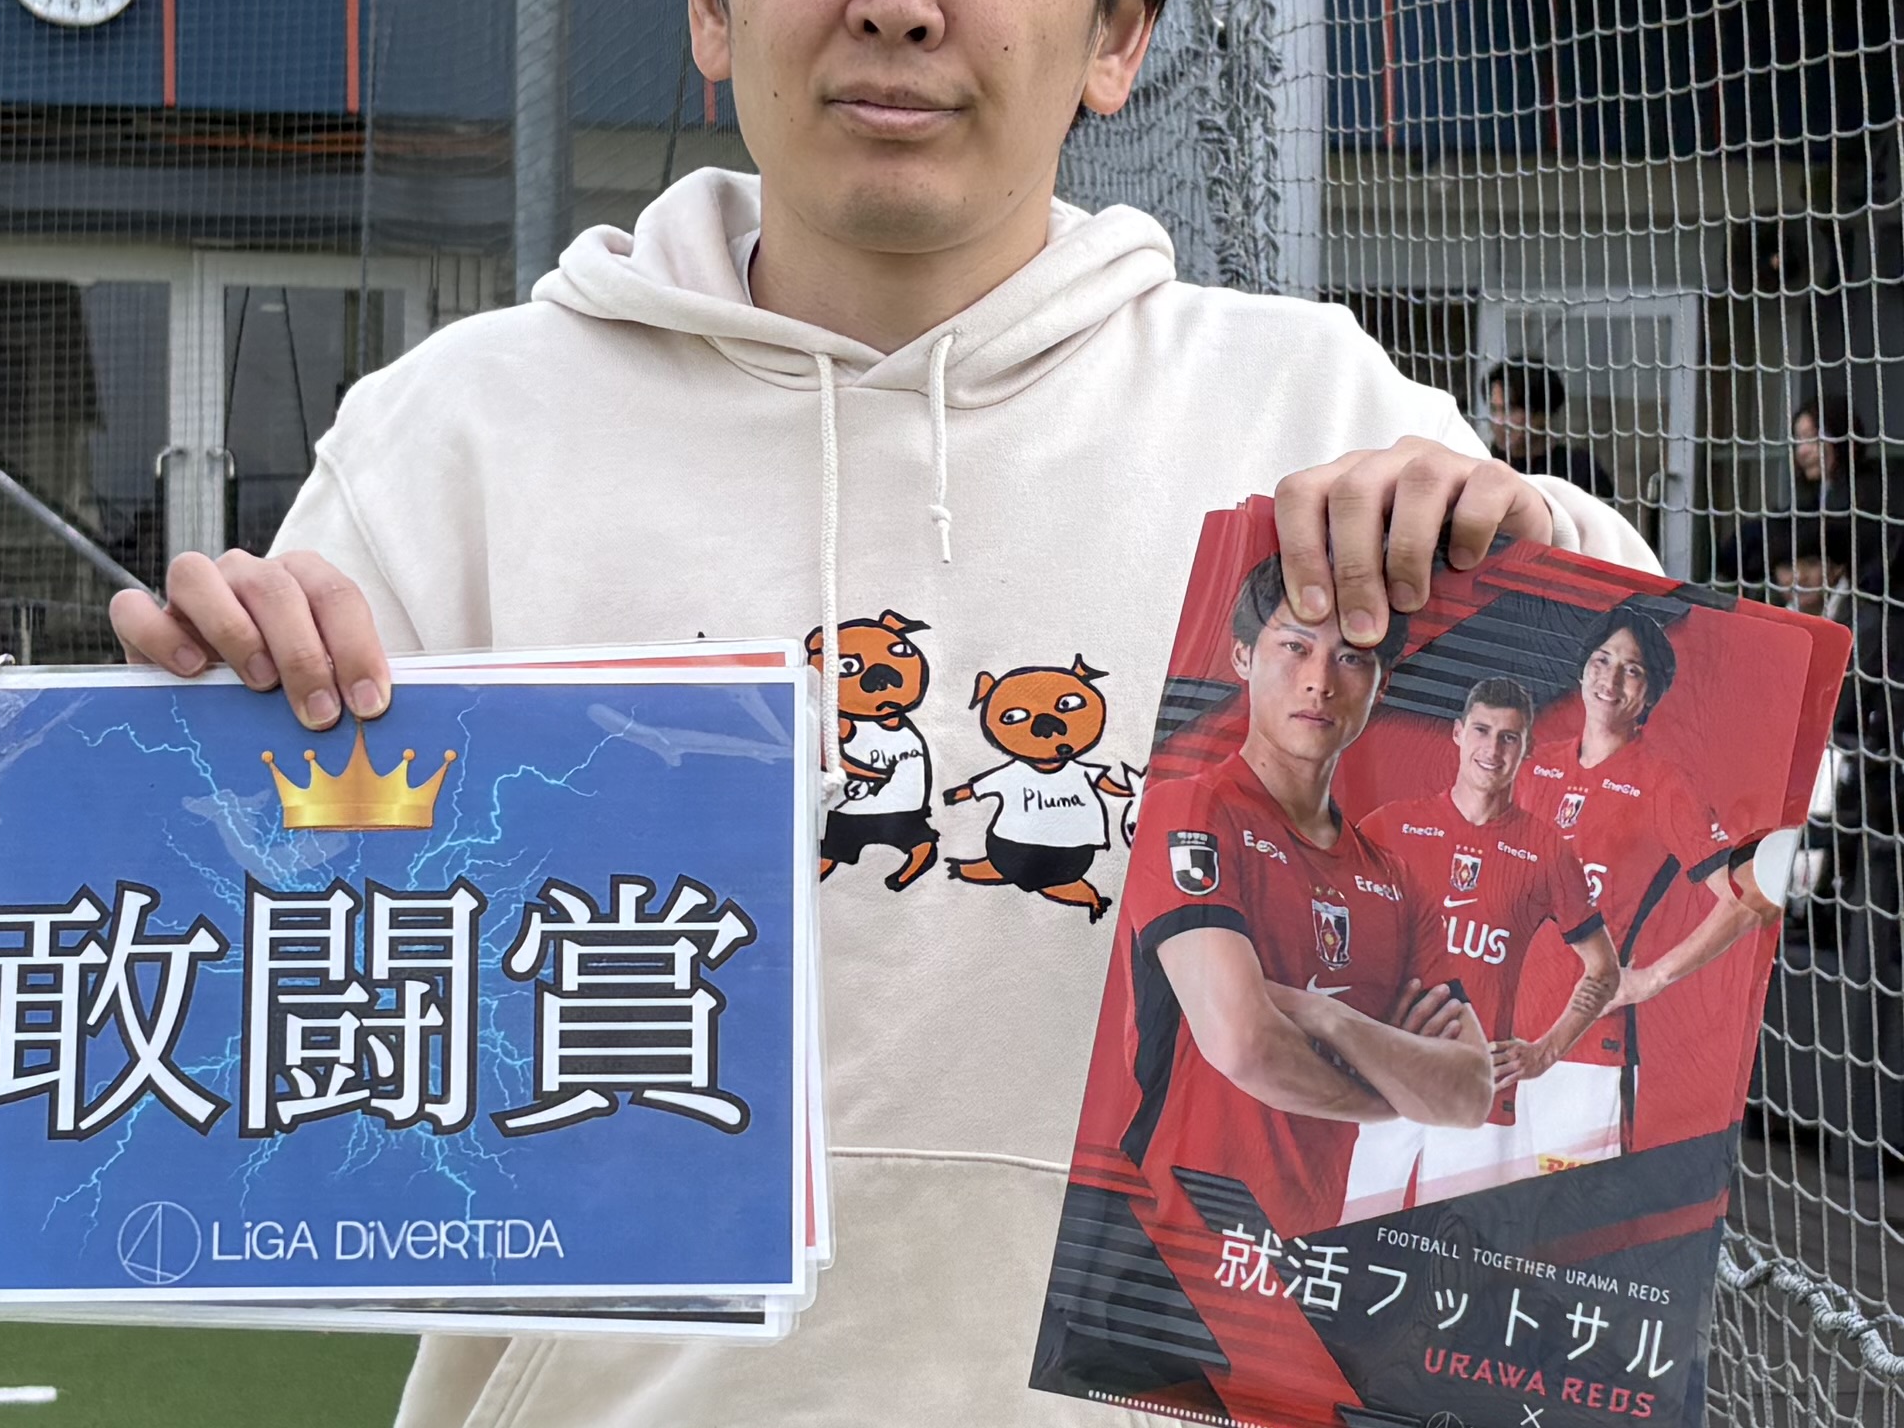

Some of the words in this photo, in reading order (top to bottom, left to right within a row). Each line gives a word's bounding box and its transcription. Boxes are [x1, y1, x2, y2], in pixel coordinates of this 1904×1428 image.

[1022, 786, 1085, 812] Pluma
[1441, 915, 1512, 966] LUS
[1214, 1223, 1674, 1379] 就活フットサル
[1377, 1227, 1461, 1260] FOOTBALL
[1472, 1247, 1557, 1281] TOGETHER
[1564, 1268, 1619, 1295] URAWA
[1628, 1281, 1671, 1305] REDS
[1423, 1347, 1547, 1397] URAWA
[1561, 1377, 1656, 1419] REDS
